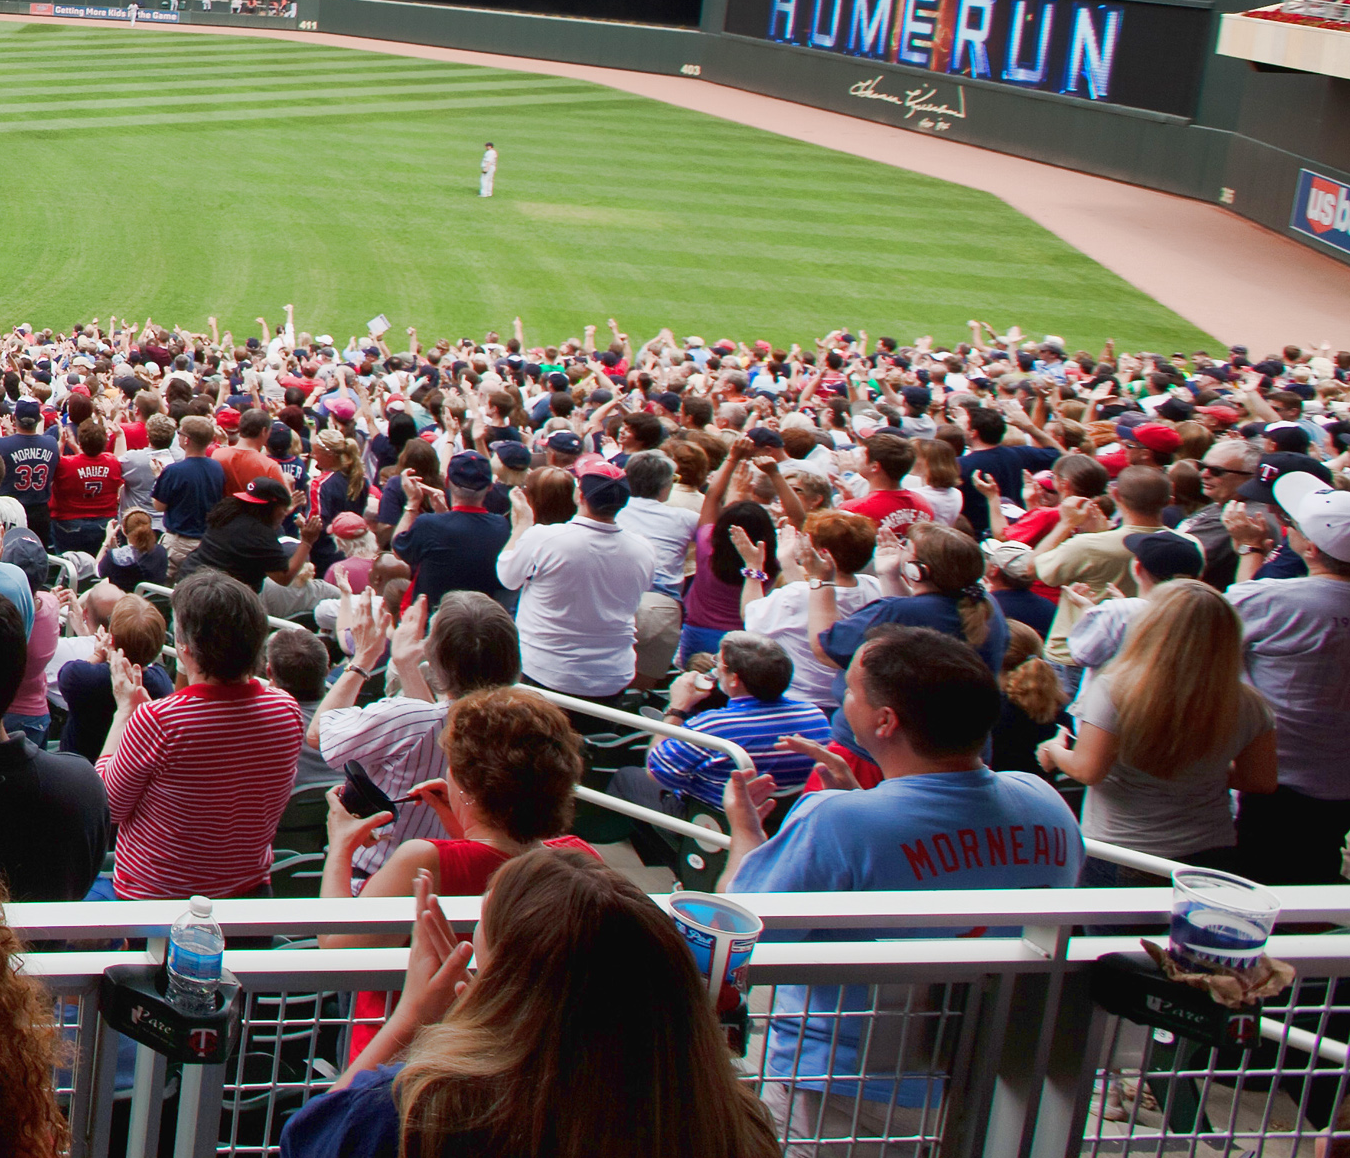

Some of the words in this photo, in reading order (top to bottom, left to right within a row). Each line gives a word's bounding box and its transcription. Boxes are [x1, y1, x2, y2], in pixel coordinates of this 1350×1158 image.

[55, 6, 84, 16] Getting
[86, 8, 107, 16] More
[108, 8, 126, 18] Kids
[138, 10, 151, 19] the
[152, 11, 177, 20] Game
[299, 20, 318, 30] 411
[11, 448, 53, 464] MORNEAU
[14, 464, 50, 491] 33
[77, 466, 109, 479] MAUER
[85, 482, 103, 498] 7
[900, 826, 1067, 881] MORNEAU
